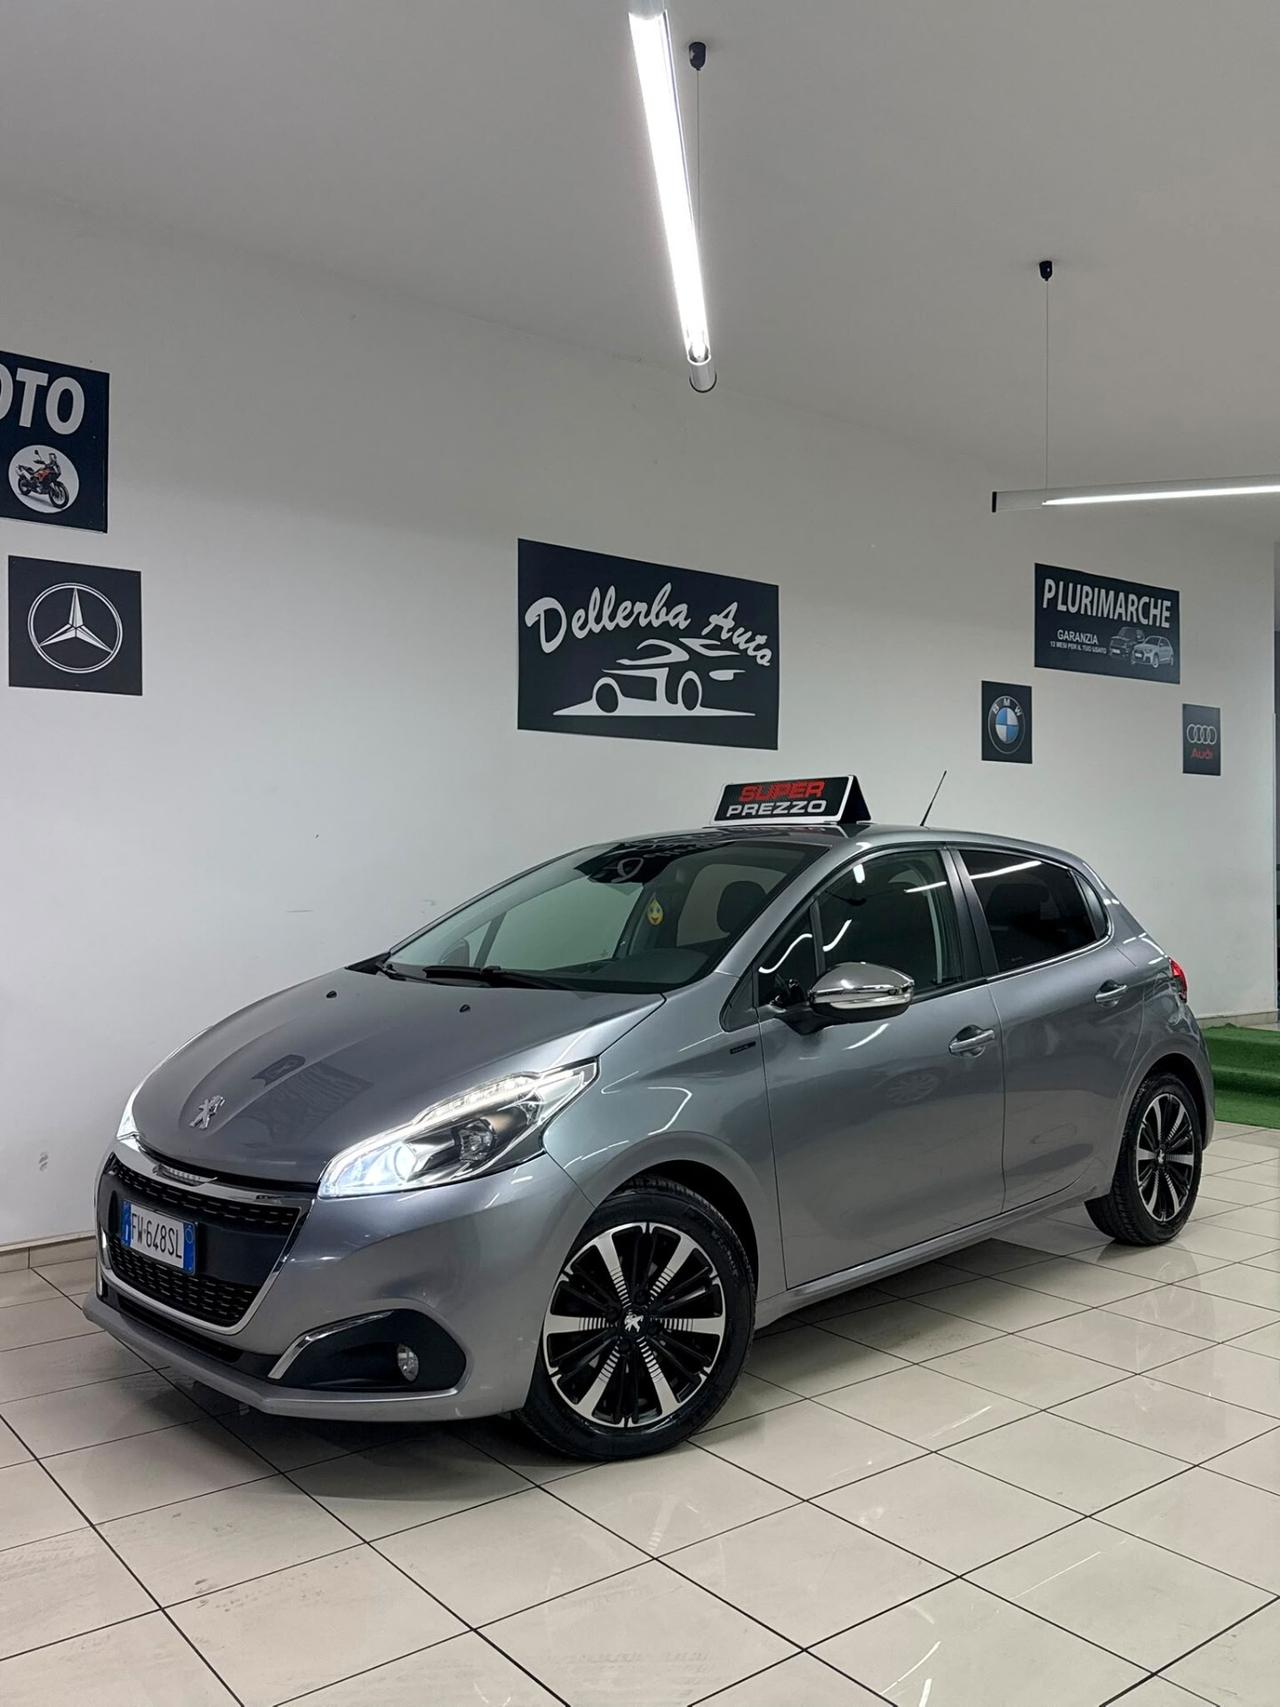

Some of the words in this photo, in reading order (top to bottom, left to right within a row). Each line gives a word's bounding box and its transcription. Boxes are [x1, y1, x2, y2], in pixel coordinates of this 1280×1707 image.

[1042, 578, 1172, 629] PLURIMARCHE
[525, 582, 692, 653] Dellerba
[701, 601, 773, 667] Auto
[1057, 629, 1099, 645] GARANZIA
[992, 698, 1023, 716] BMW
[1190, 747, 1213, 760] Audi
[740, 780, 826, 804] SUPER
[726, 800, 828, 817] PREZZO
